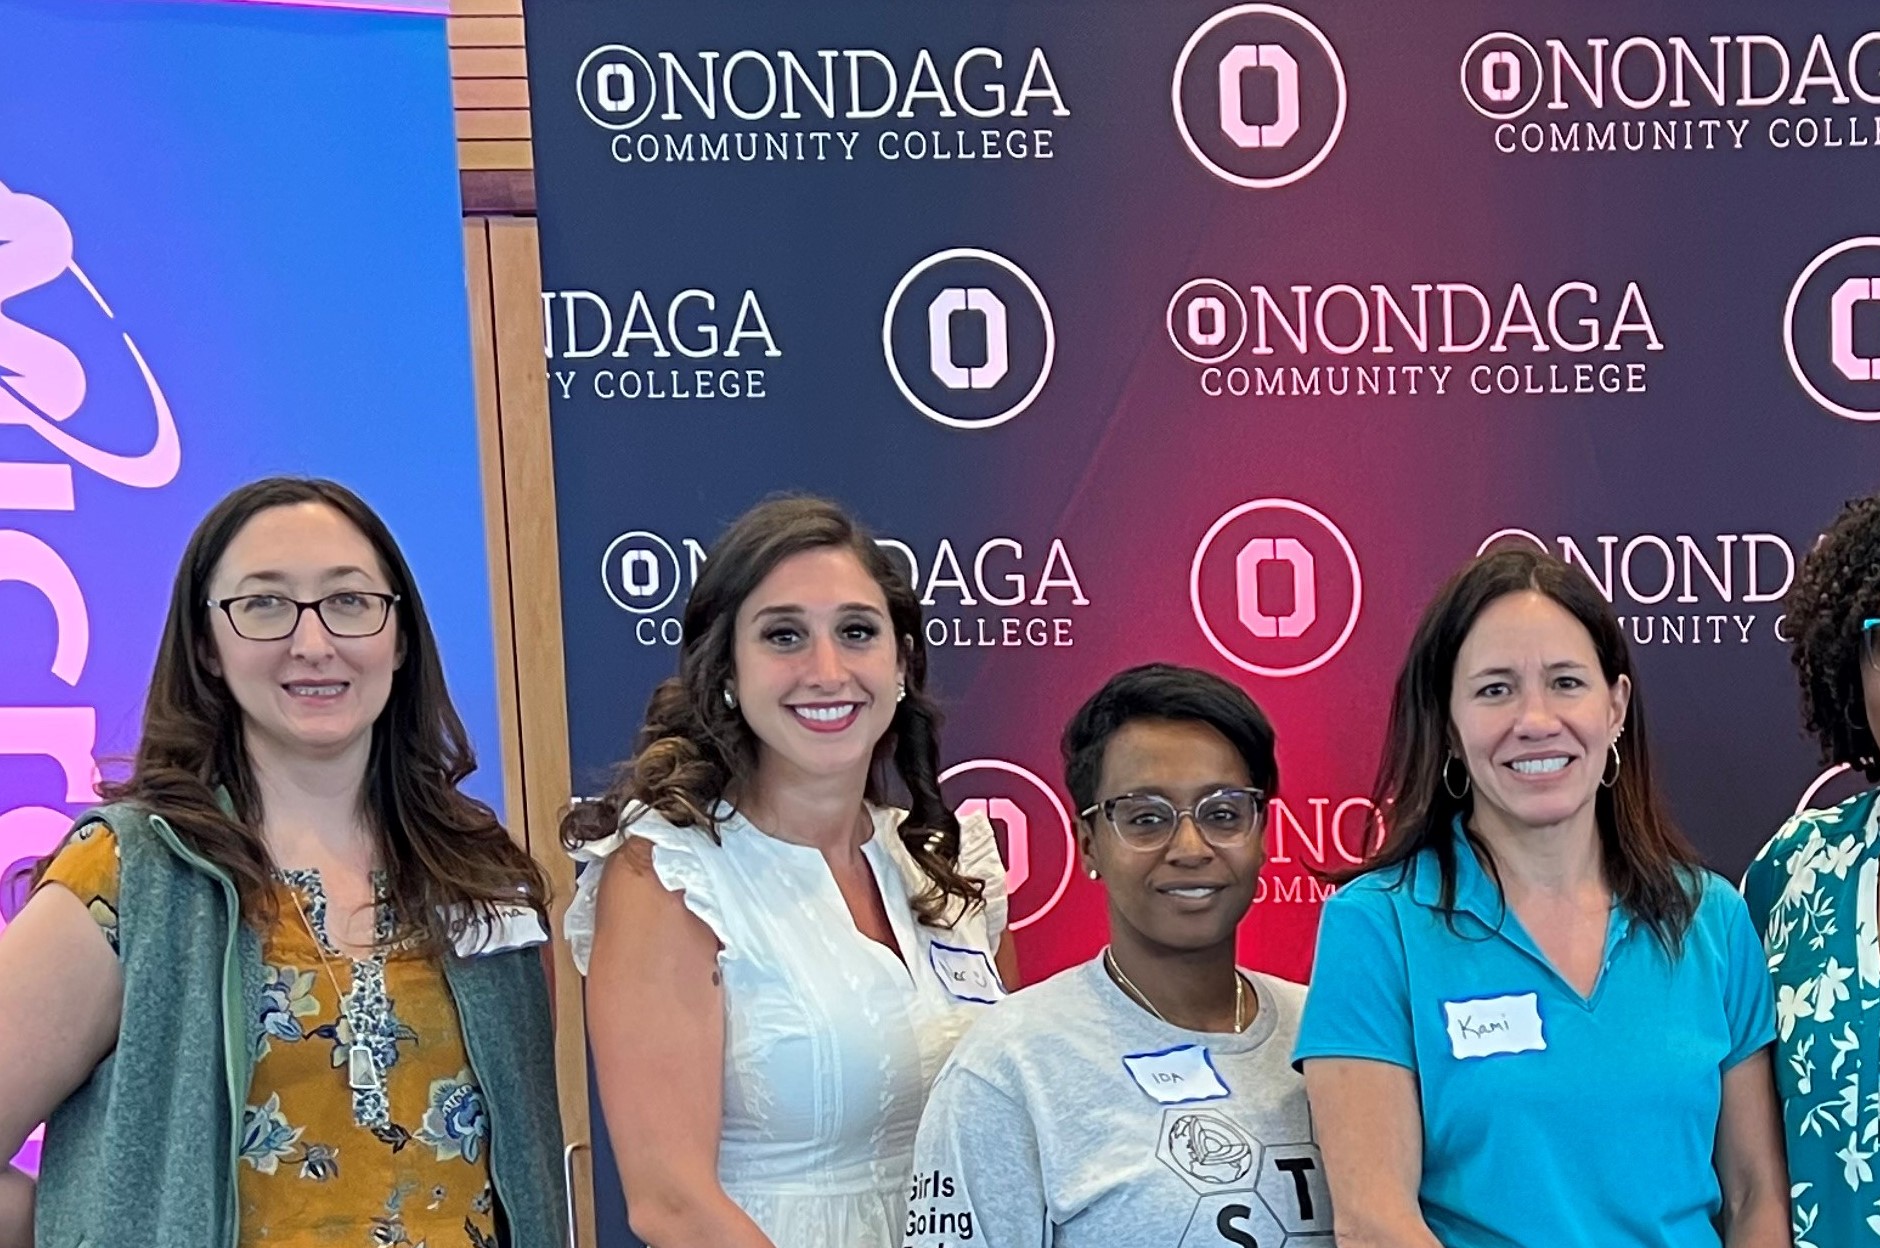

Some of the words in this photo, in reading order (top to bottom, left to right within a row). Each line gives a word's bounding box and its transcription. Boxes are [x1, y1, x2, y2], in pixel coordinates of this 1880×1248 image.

[576, 44, 1071, 131] ONONDAGA
[611, 131, 860, 163] COMMUNITY
[878, 129, 1054, 160] COLLEGE
[1494, 119, 1750, 153] COMMUNITY
[1166, 278, 1664, 364] ONONDAGA
[594, 369, 766, 399] COLLEGE
[1200, 365, 1452, 397] COMMUNITY
[1470, 363, 1646, 395] COLLEGE
[926, 618, 1074, 647] OLLEGE
[1618, 614, 1756, 644] UNITY
